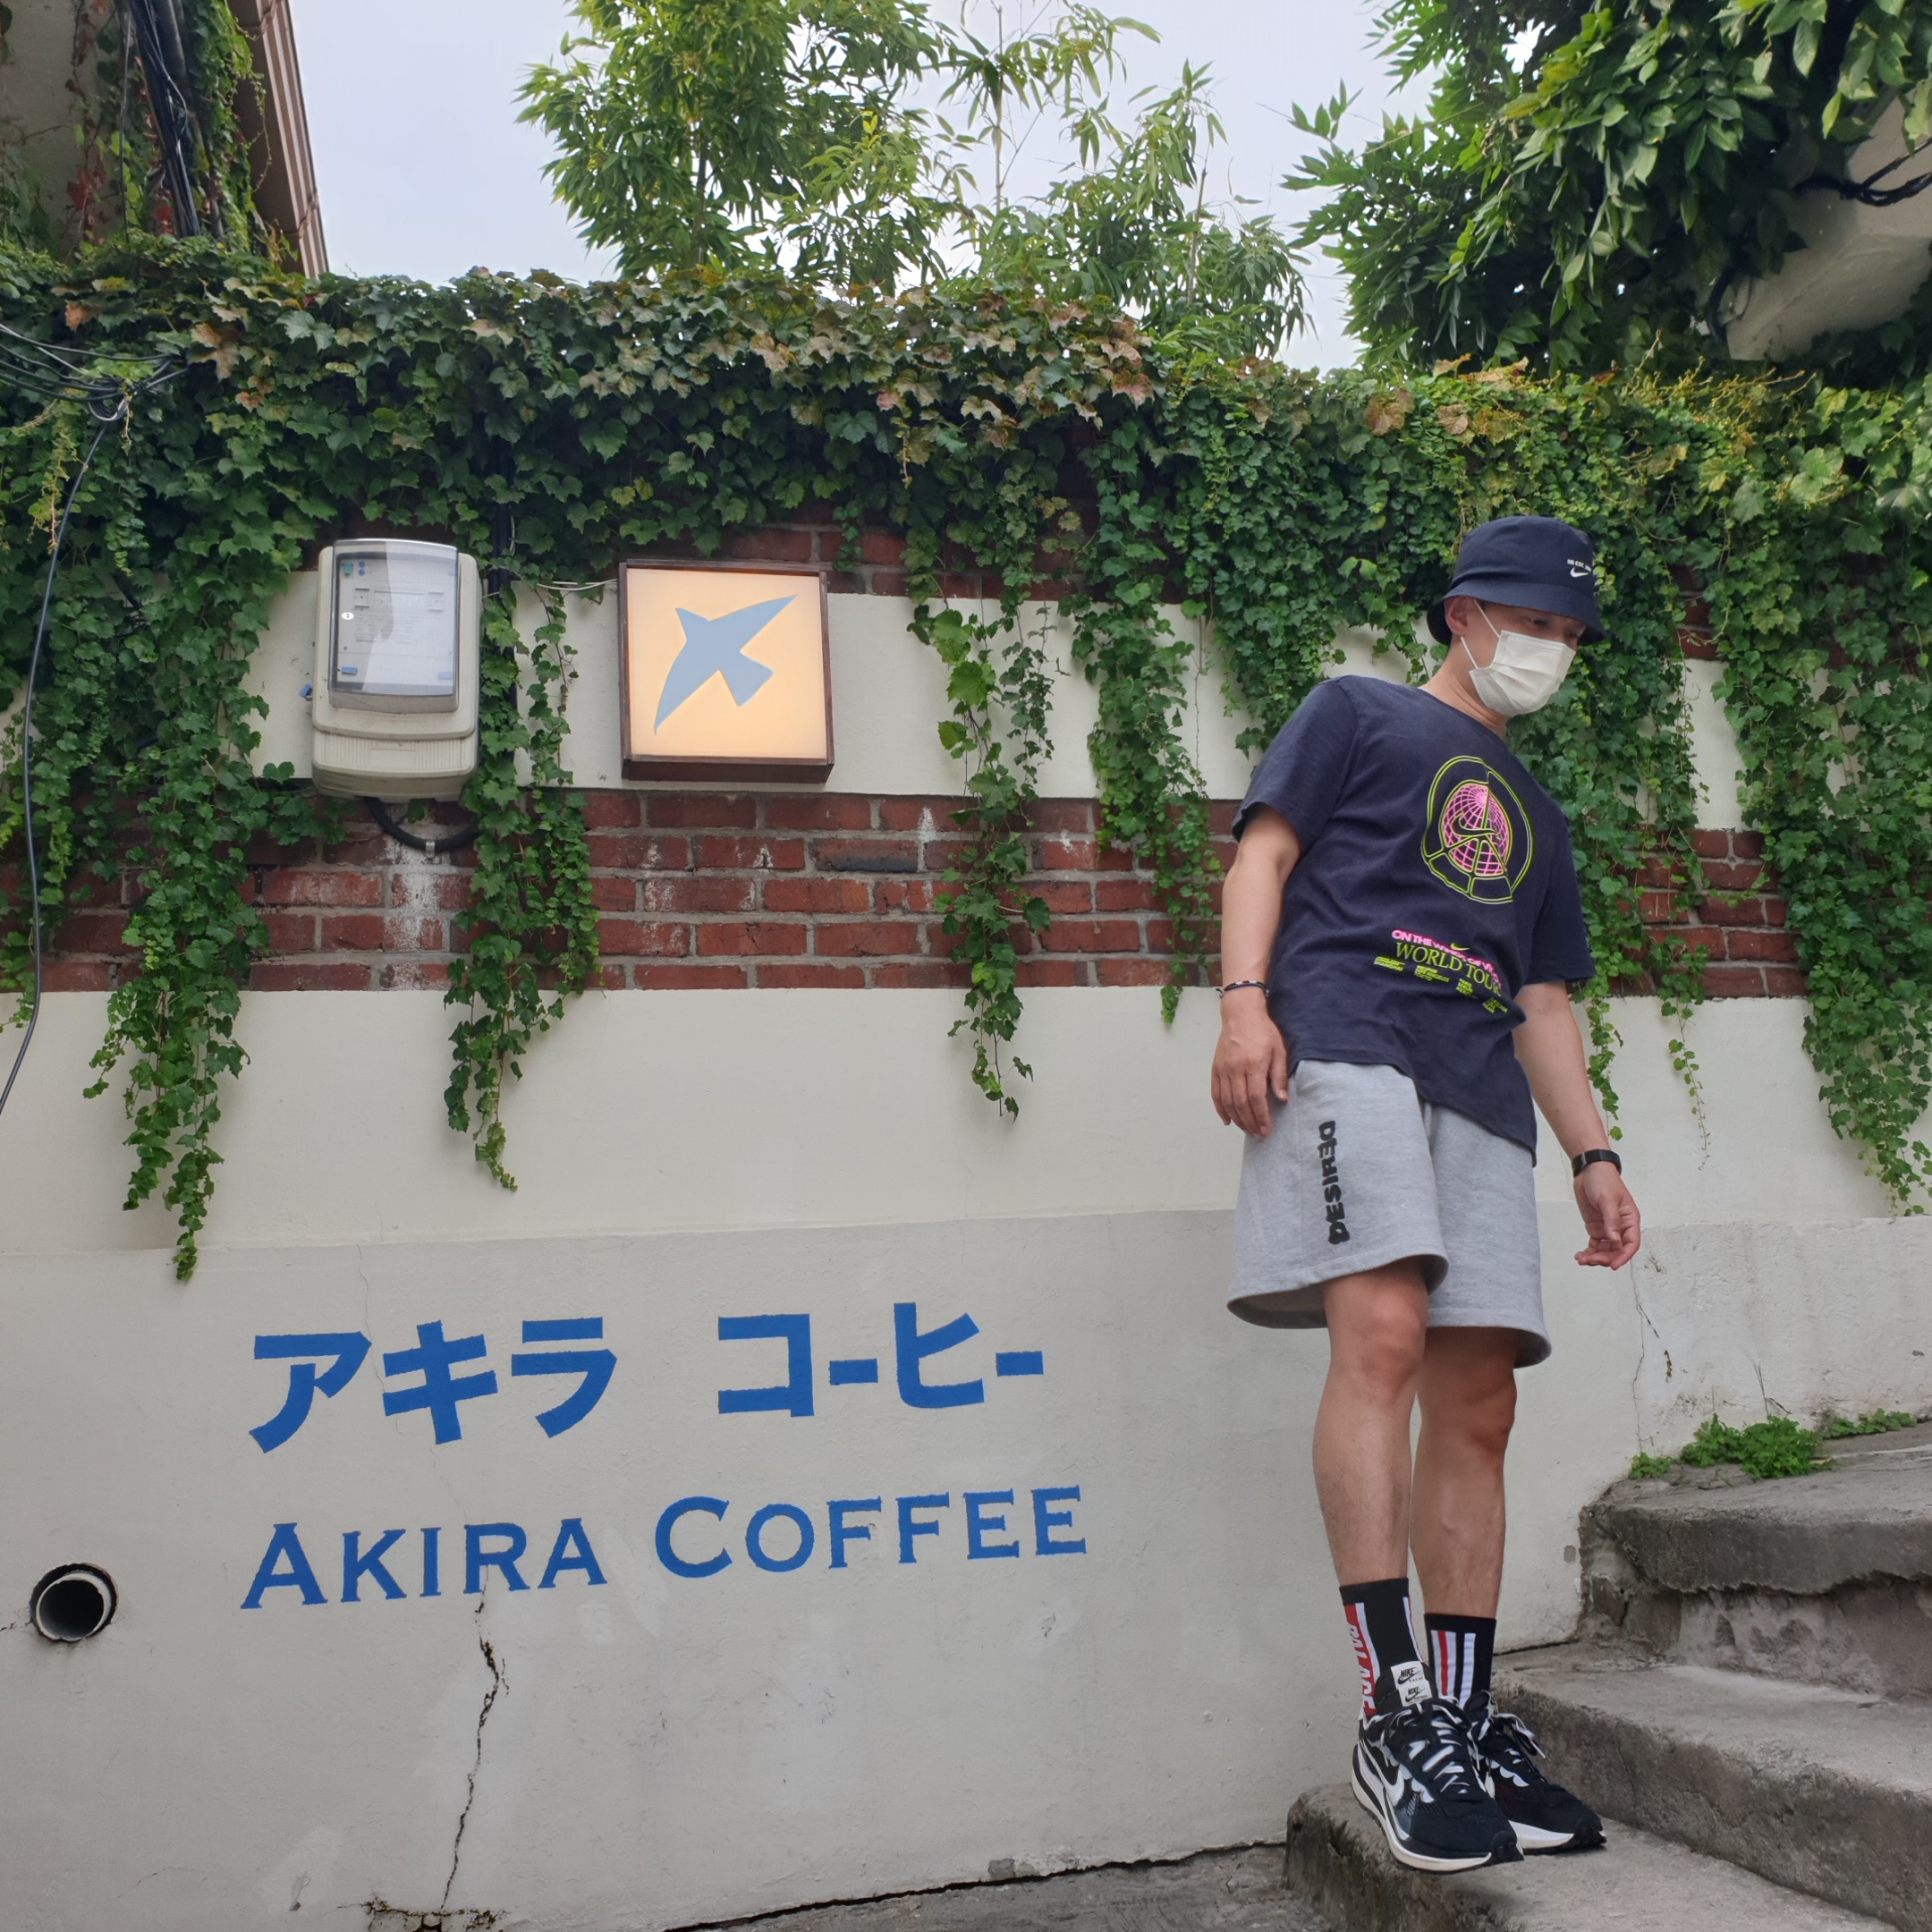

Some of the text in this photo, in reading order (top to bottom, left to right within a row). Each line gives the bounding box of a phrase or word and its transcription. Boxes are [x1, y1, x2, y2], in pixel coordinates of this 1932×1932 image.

[1392, 930, 1412, 942] ON
[1412, 935, 1433, 946] THE
[1396, 942, 1463, 971] WORLD
[1466, 963, 1502, 997] TOUR
[1317, 1120, 1351, 1245] DESIRED
[249, 1302, 1044, 1453] アキラ コーヒー
[241, 1485, 1087, 1609] AKIRA COFFEE
[1400, 1666, 1418, 1678] NIKE
